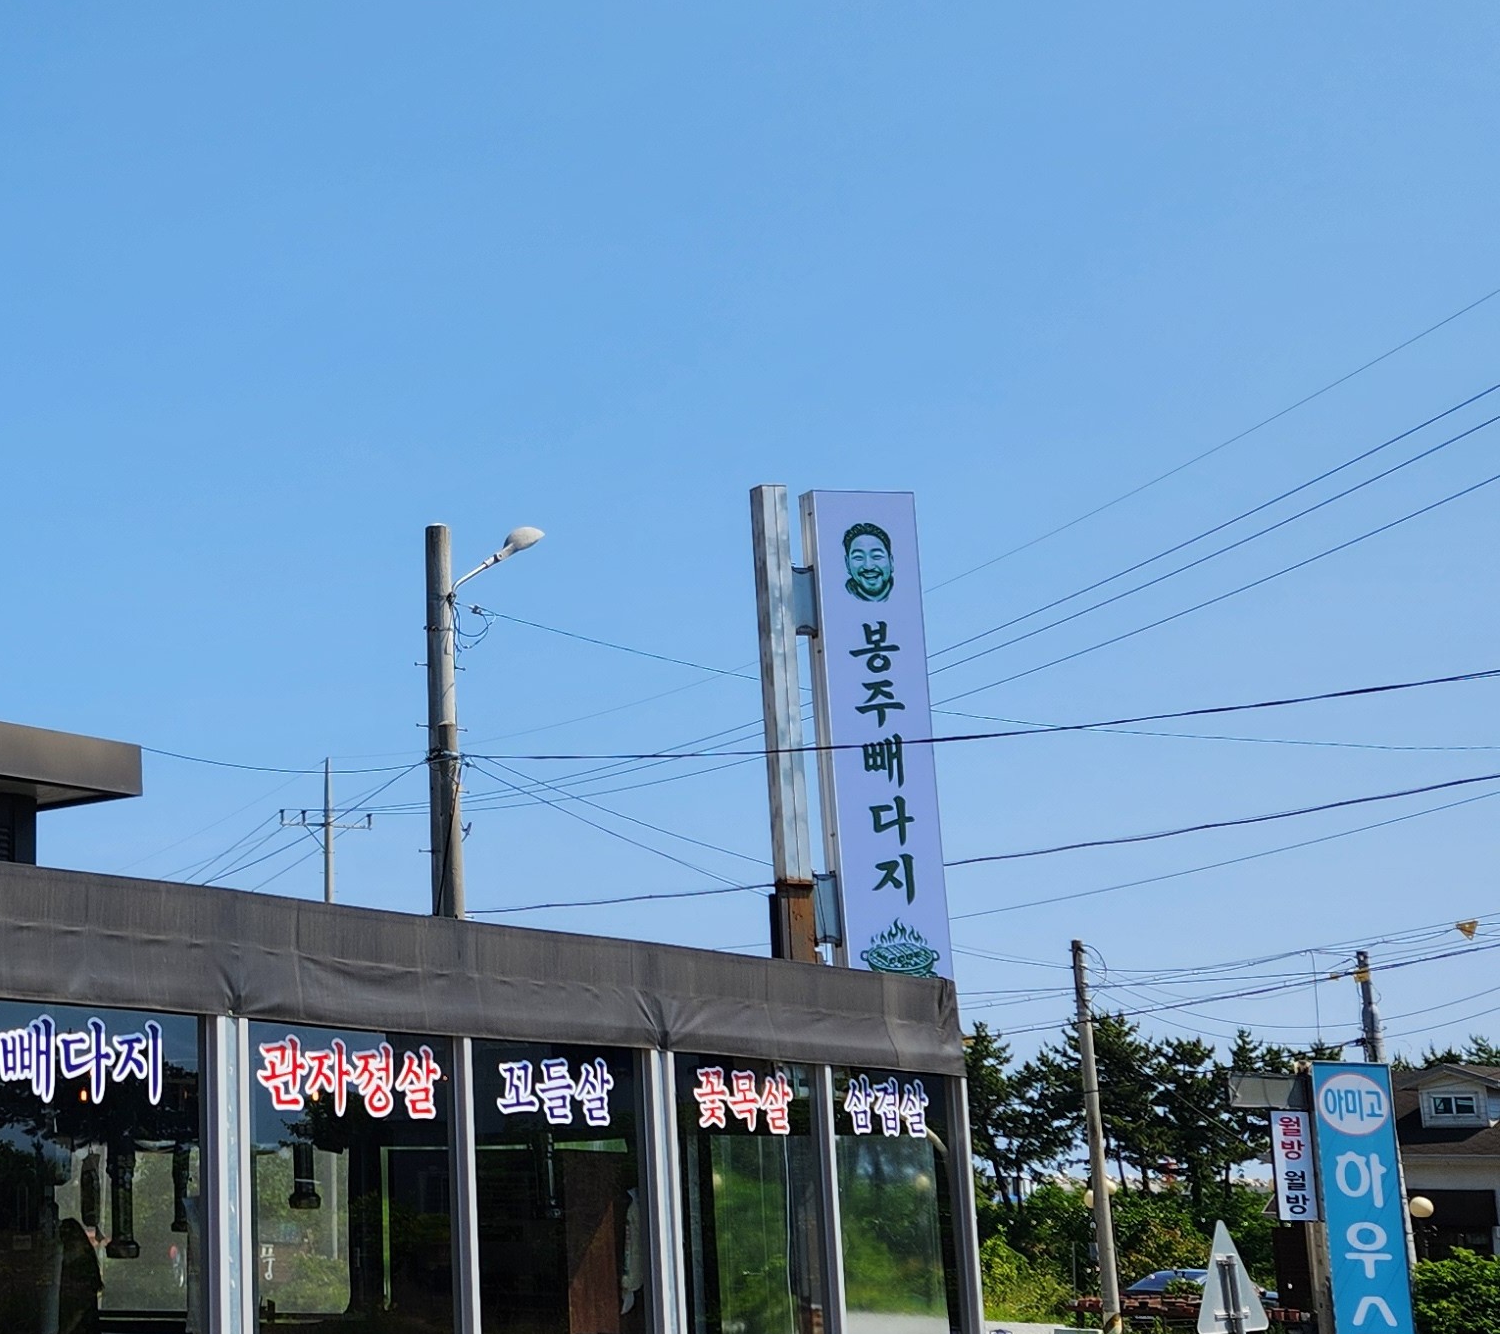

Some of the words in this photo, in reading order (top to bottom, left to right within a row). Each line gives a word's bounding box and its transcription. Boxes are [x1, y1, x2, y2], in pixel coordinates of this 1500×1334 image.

[257, 1034, 441, 1119] 관자정살
[497, 1057, 614, 1126] 꼬들살
[693, 1066, 793, 1135] 꽃목살
[844, 1074, 929, 1138] 삼겹살
[1323, 1088, 1387, 1121] 아미고
[1279, 1116, 1305, 1160] 월방
[1284, 1170, 1310, 1214] 월방
